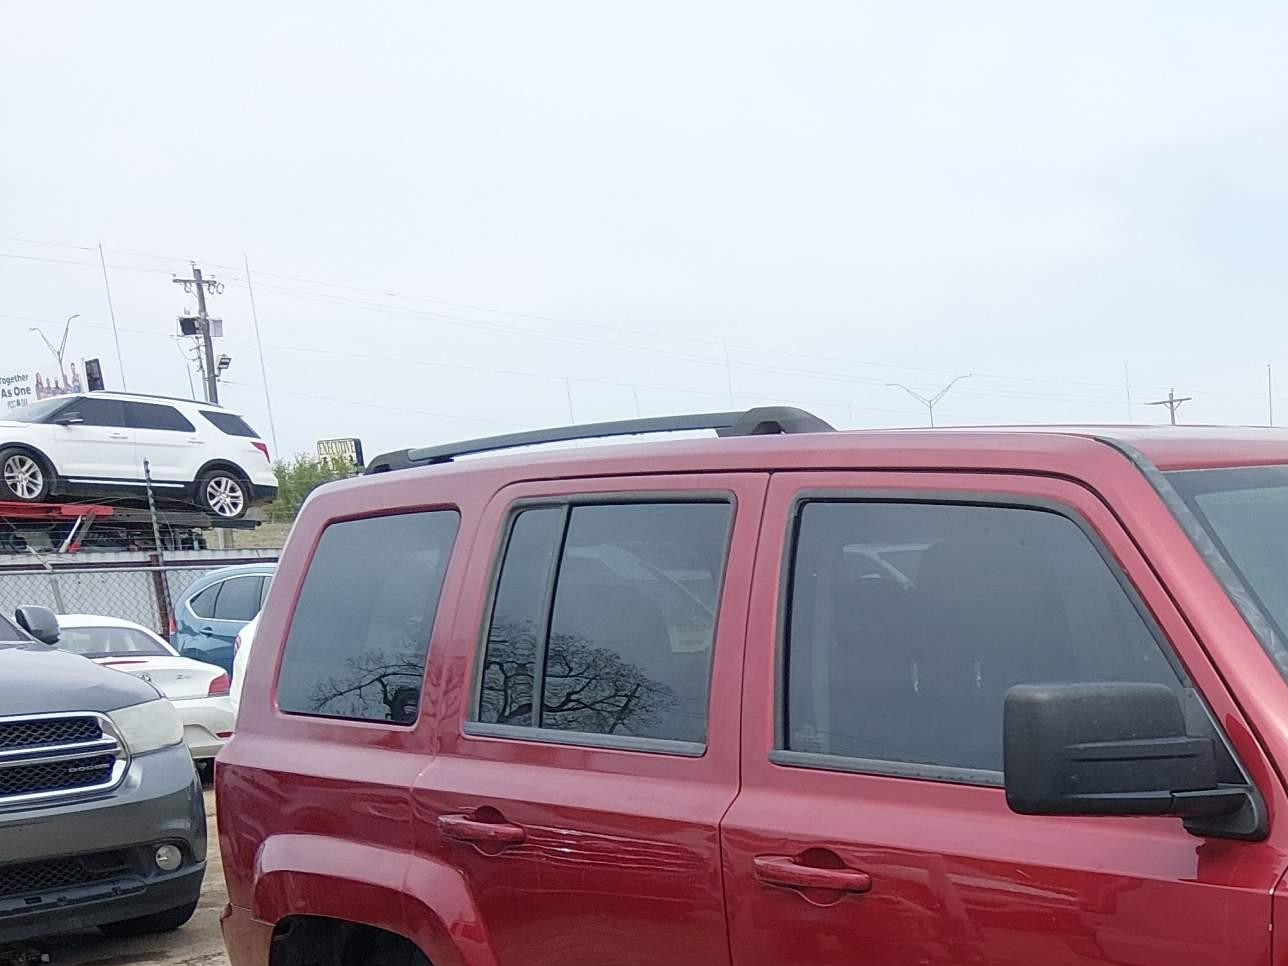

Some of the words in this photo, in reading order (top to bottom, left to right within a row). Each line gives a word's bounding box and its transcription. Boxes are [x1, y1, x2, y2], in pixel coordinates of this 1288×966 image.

[1, 388, 13, 399] As
[14, 386, 31, 396] One
[68, 763, 110, 773] DODGE
